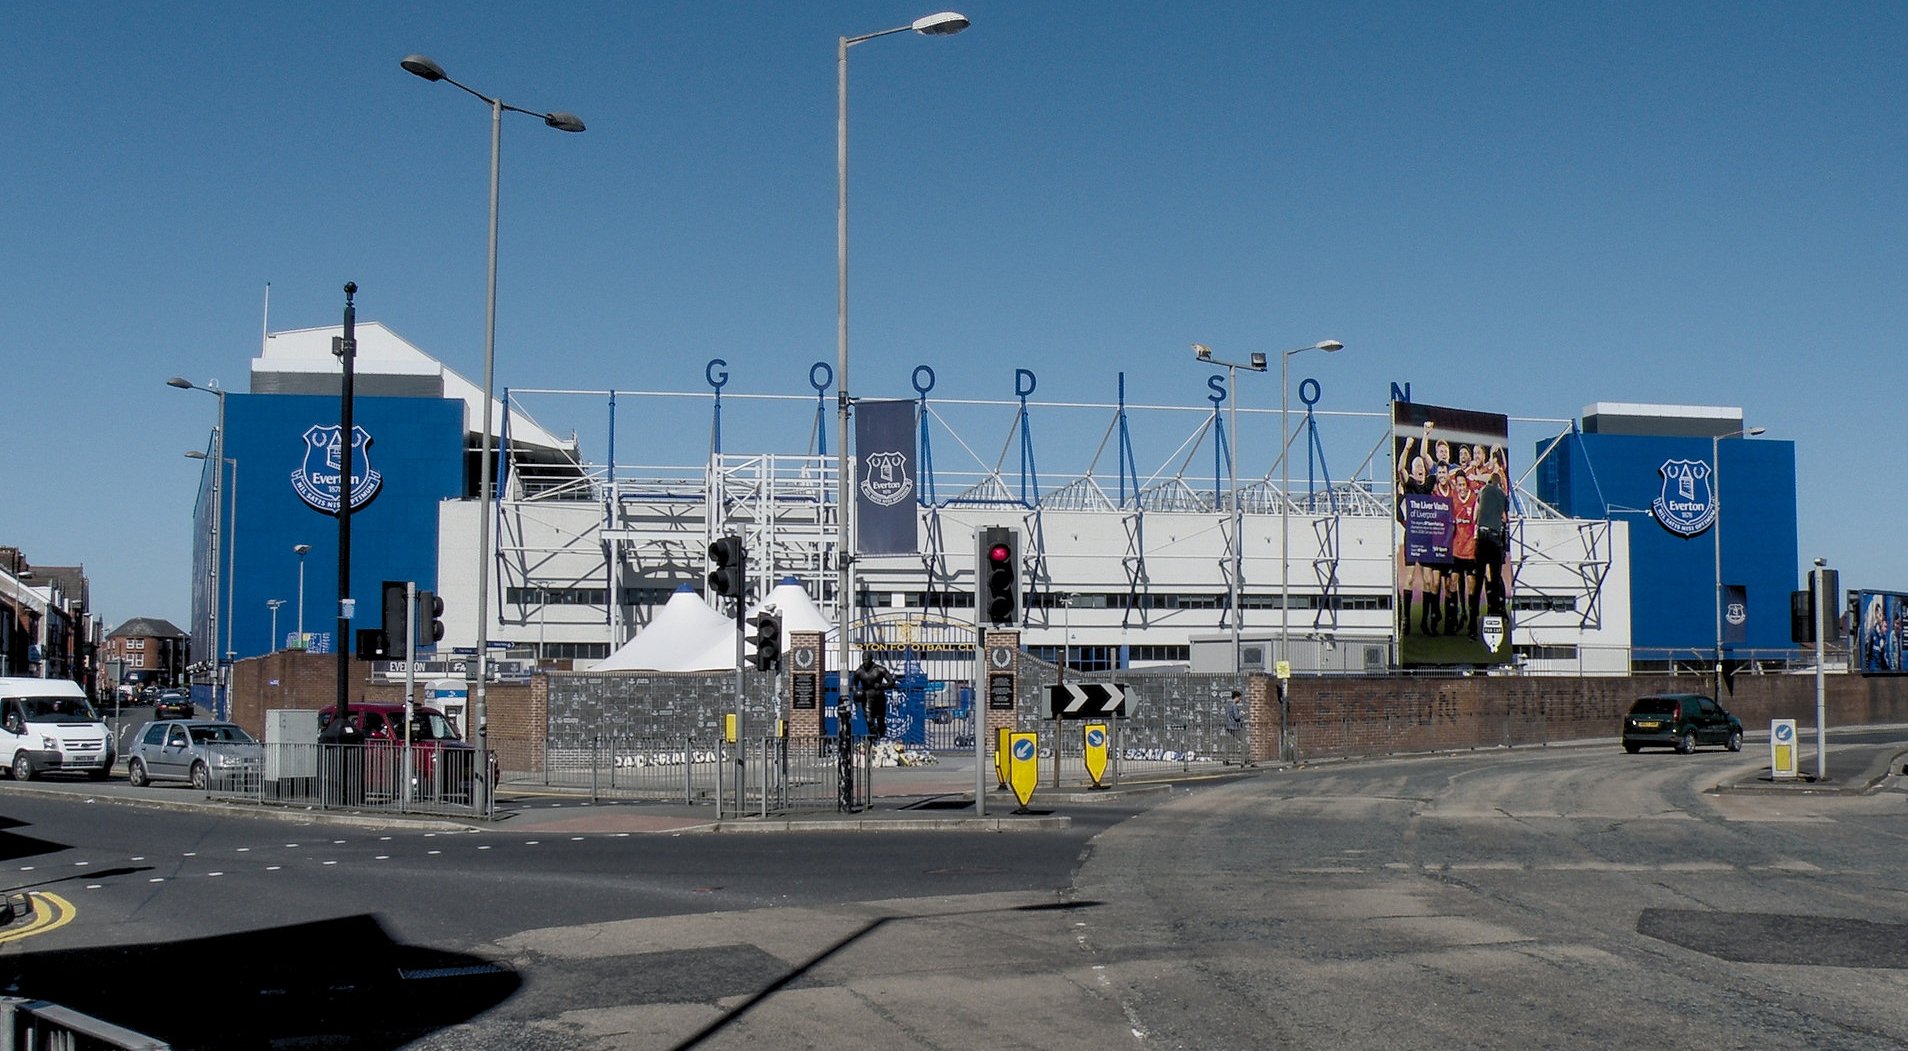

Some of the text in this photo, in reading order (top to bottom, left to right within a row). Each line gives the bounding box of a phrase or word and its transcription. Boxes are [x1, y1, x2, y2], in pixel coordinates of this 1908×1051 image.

[312, 472, 359, 484] Evertn
[872, 481, 900, 489] Everton
[306, 493, 325, 506] SATIS
[351, 482, 376, 505] PTIMUM
[1410, 500, 1448, 510] The Liver Vaults
[1669, 500, 1704, 510] Everton
[389, 661, 425, 671] EVEON
